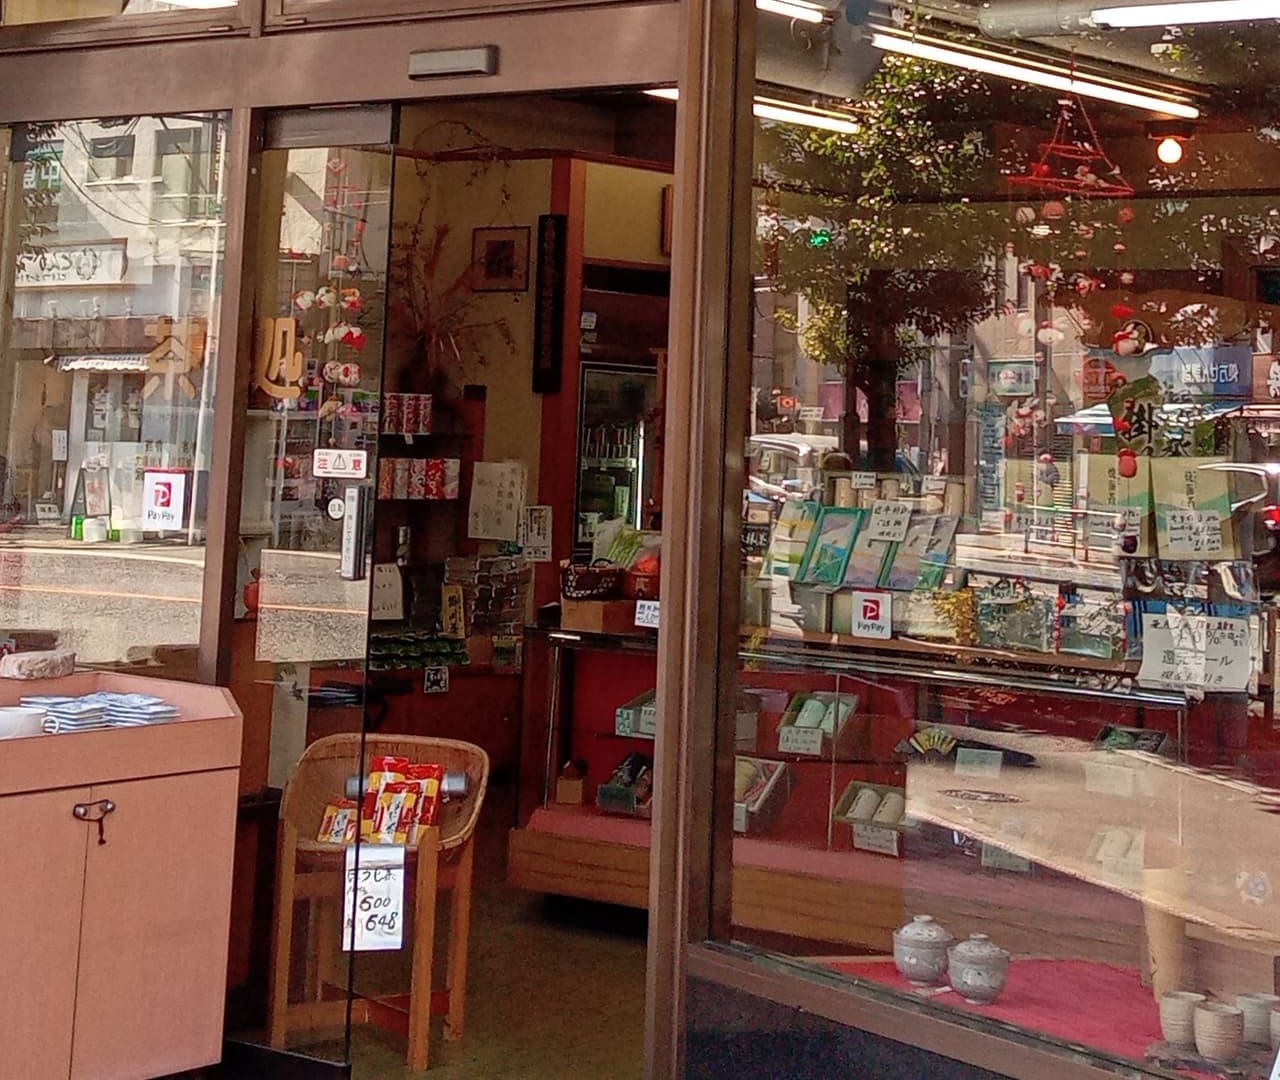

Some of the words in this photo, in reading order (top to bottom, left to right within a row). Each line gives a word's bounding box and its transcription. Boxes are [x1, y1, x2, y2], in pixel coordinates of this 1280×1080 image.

[147, 509, 175, 522] PayPay
[857, 622, 885, 634] PayPay
[365, 911, 399, 932] 648
